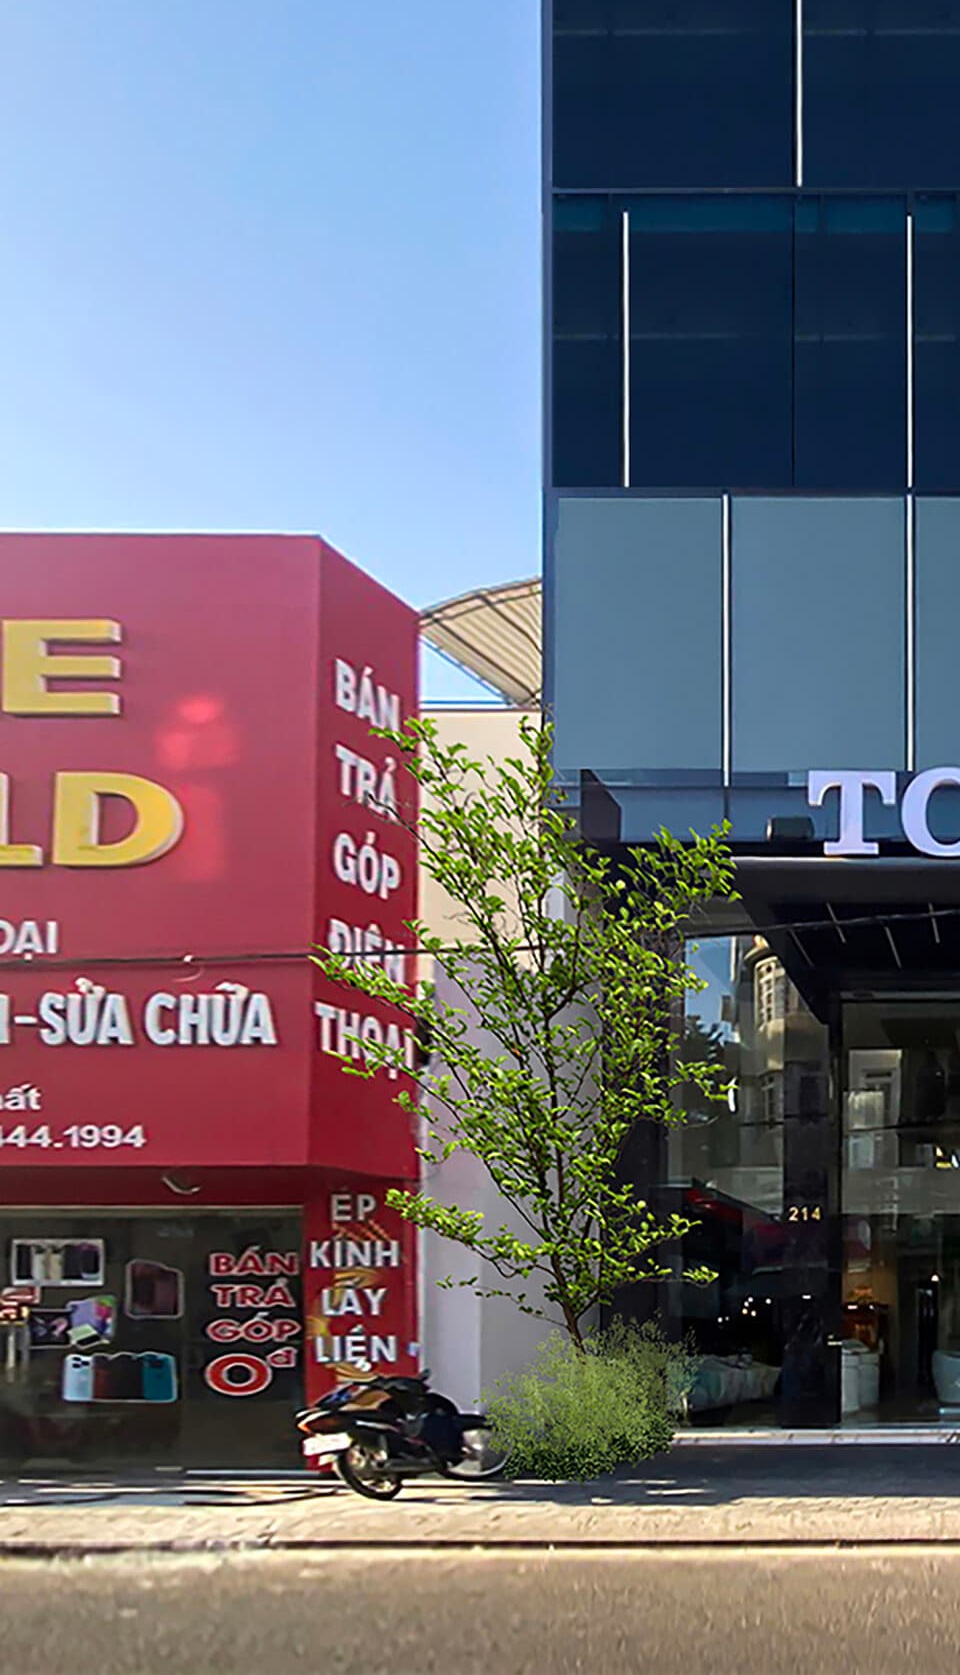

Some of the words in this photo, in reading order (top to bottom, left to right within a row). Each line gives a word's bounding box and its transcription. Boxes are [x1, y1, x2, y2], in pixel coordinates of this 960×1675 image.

[336, 658, 399, 734] BÁN
[336, 743, 398, 822] TRẢ
[334, 831, 400, 900] GÓP
[145, 981, 278, 1045] CHỮA
[788, 1206, 821, 1221] 214
[209, 1245, 299, 1275] BÁN
[310, 1230, 400, 1268] KÍNH
[209, 1277, 296, 1307] TRẢ
[206, 1311, 301, 1342] GÓP
